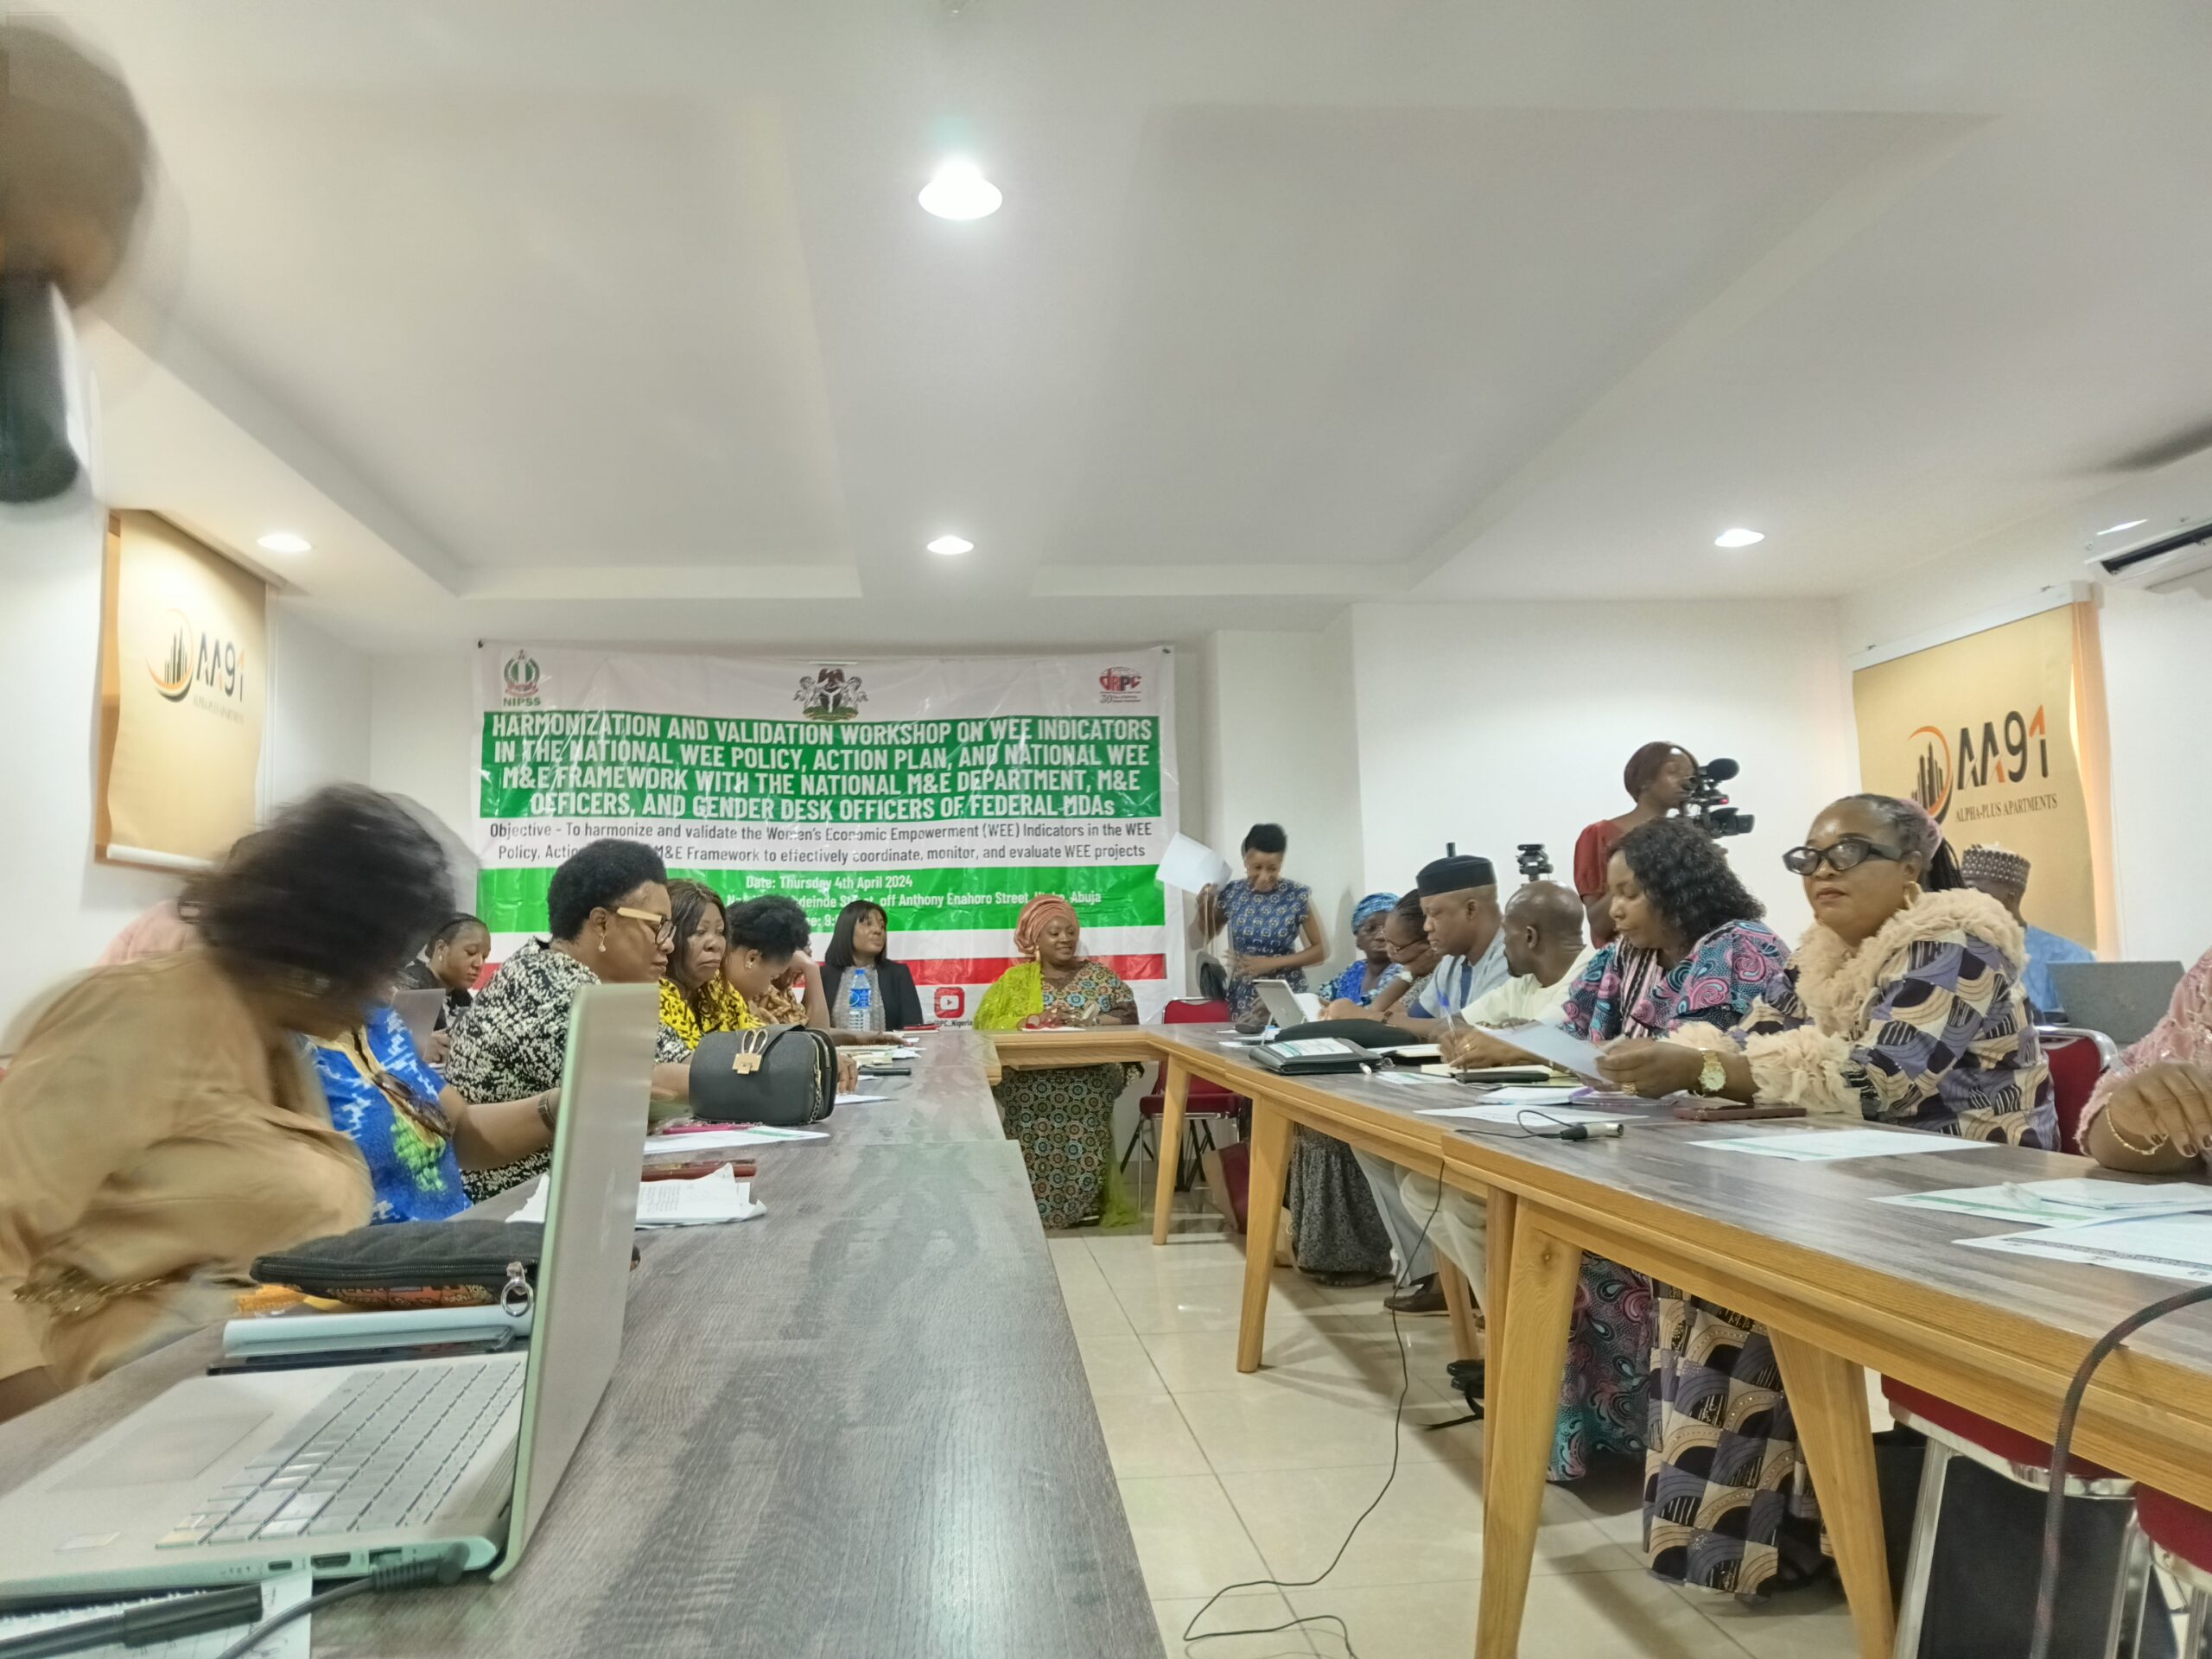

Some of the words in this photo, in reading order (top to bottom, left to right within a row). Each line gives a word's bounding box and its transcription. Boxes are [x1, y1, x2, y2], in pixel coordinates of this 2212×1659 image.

[504, 697, 541, 707] NIPSS
[493, 714, 660, 738] HARMONIZATION
[668, 719, 709, 741] AND
[715, 721, 833, 745] VALIDATION
[841, 722, 950, 745] WORKSHOP
[957, 721, 983, 742] ON
[989, 719, 1032, 741] WEE
[1039, 719, 1152, 741] INDICATORS
[494, 741, 515, 763] IN
[522, 741, 563, 763] THE
[570, 741, 673, 764] NATIONAL
[680, 745, 725, 767] WEE
[732, 747, 806, 772] POLICY,
[814, 748, 887, 771] ACTION
[894, 748, 952, 771] PLAN,
[959, 746, 997, 767] AND
[1005, 744, 1100, 767] NATIONAL
[1107, 744, 1149, 766] WEE
[1957, 704, 2049, 790] AA91
[503, 766, 550, 789] M&E
[557, 766, 688, 791] FRAMEWORK
[695, 771, 748, 793] WITH
[755, 773, 792, 796] THE
[801, 774, 900, 796] NATIONAL
[907, 772, 950, 794] M&E
[957, 769, 1090, 792] DEPARTMENT,
[1098, 769, 1140, 791] M&E
[531, 792, 635, 817] OFFICERS,
[642, 795, 685, 817] AND
[692, 798, 774, 820] GENDER
[781, 799, 832, 821] DESK
[840, 797, 935, 820] OFFICERS
[940, 796, 964, 818] OF
[970, 794, 1058, 817] FEDERAL
[1064, 794, 1115, 817] MDAs
[1955, 801, 2002, 823] ALPHA-PLUS
[2004, 794, 2057, 817] APARTMENTS
[490, 823, 551, 840] Objective
[566, 823, 581, 836] To
[585, 823, 652, 837] harmonize
[658, 823, 682, 838] and
[685, 824, 737, 841] validate
[741, 826, 762, 841] the
[826, 827, 887, 842] Economic
[891, 823, 979, 842] Empowerment
[982, 822, 1020, 839] (WEE)
[1023, 823, 1084, 838] Indicators
[1087, 823, 1099, 836] in
[1103, 822, 1122, 836] the
[1125, 822, 1152, 836] WEE
[499, 845, 540, 861] Policy,
[687, 846, 760, 861] Framework
[765, 849, 776, 861] to
[780, 849, 849, 865] effectively
[852, 847, 924, 863] coordinate,
[927, 846, 979, 861] monitor,
[983, 844, 1006, 858] and
[1009, 844, 1061, 859] evaluate
[1065, 844, 1090, 858] WEE
[1095, 843, 1145, 861] projects
[746, 875, 776, 888] Date:
[779, 876, 831, 891] Thursday
[835, 876, 854, 889] 4th
[856, 875, 882, 891] April
[885, 874, 912, 888] 2024
[880, 894, 896, 906] off
[899, 893, 944, 908] Anthony
[947, 892, 992, 906] Enahoro
[995, 891, 1028, 904] Street
[1071, 890, 1102, 906] Abuja
